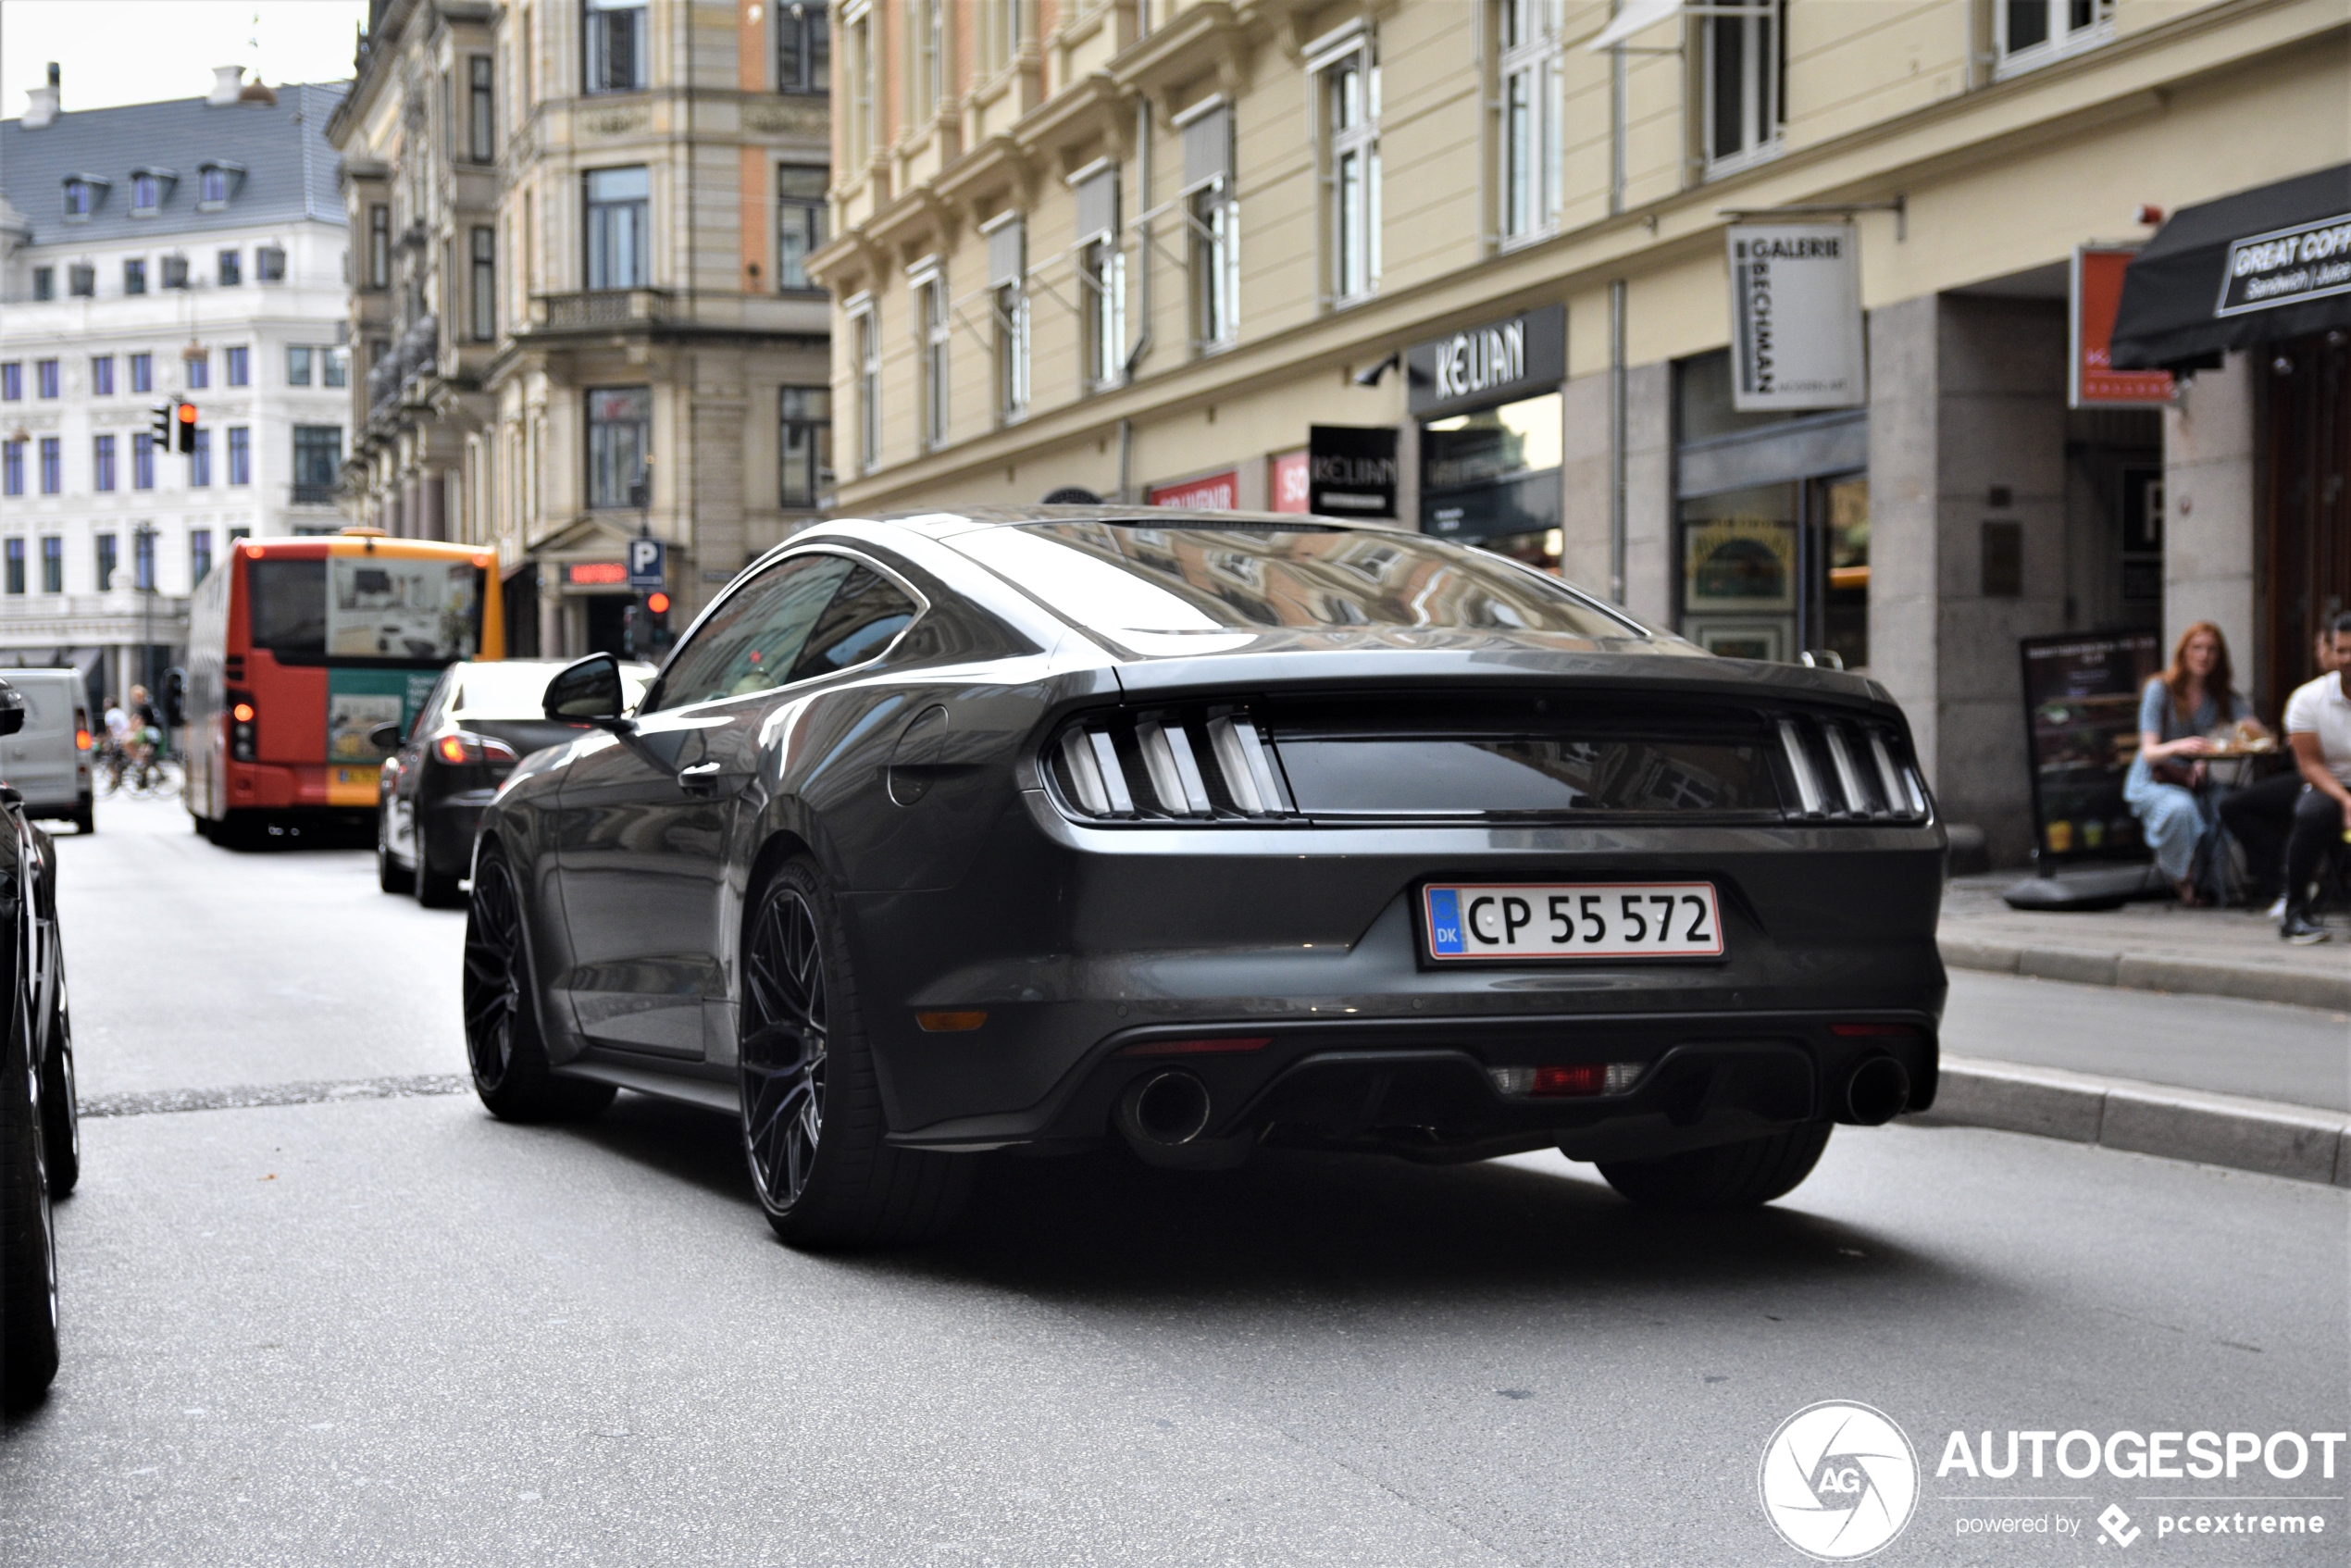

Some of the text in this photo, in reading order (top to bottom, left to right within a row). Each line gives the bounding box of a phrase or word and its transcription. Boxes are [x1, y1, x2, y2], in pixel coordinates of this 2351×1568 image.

[1752, 238, 1840, 258] GALERIE
[2233, 235, 2300, 277] GREAT
[633, 541, 658, 574] P
[1437, 928, 1458, 943] DK
[1468, 894, 1710, 945] CP 55 572
